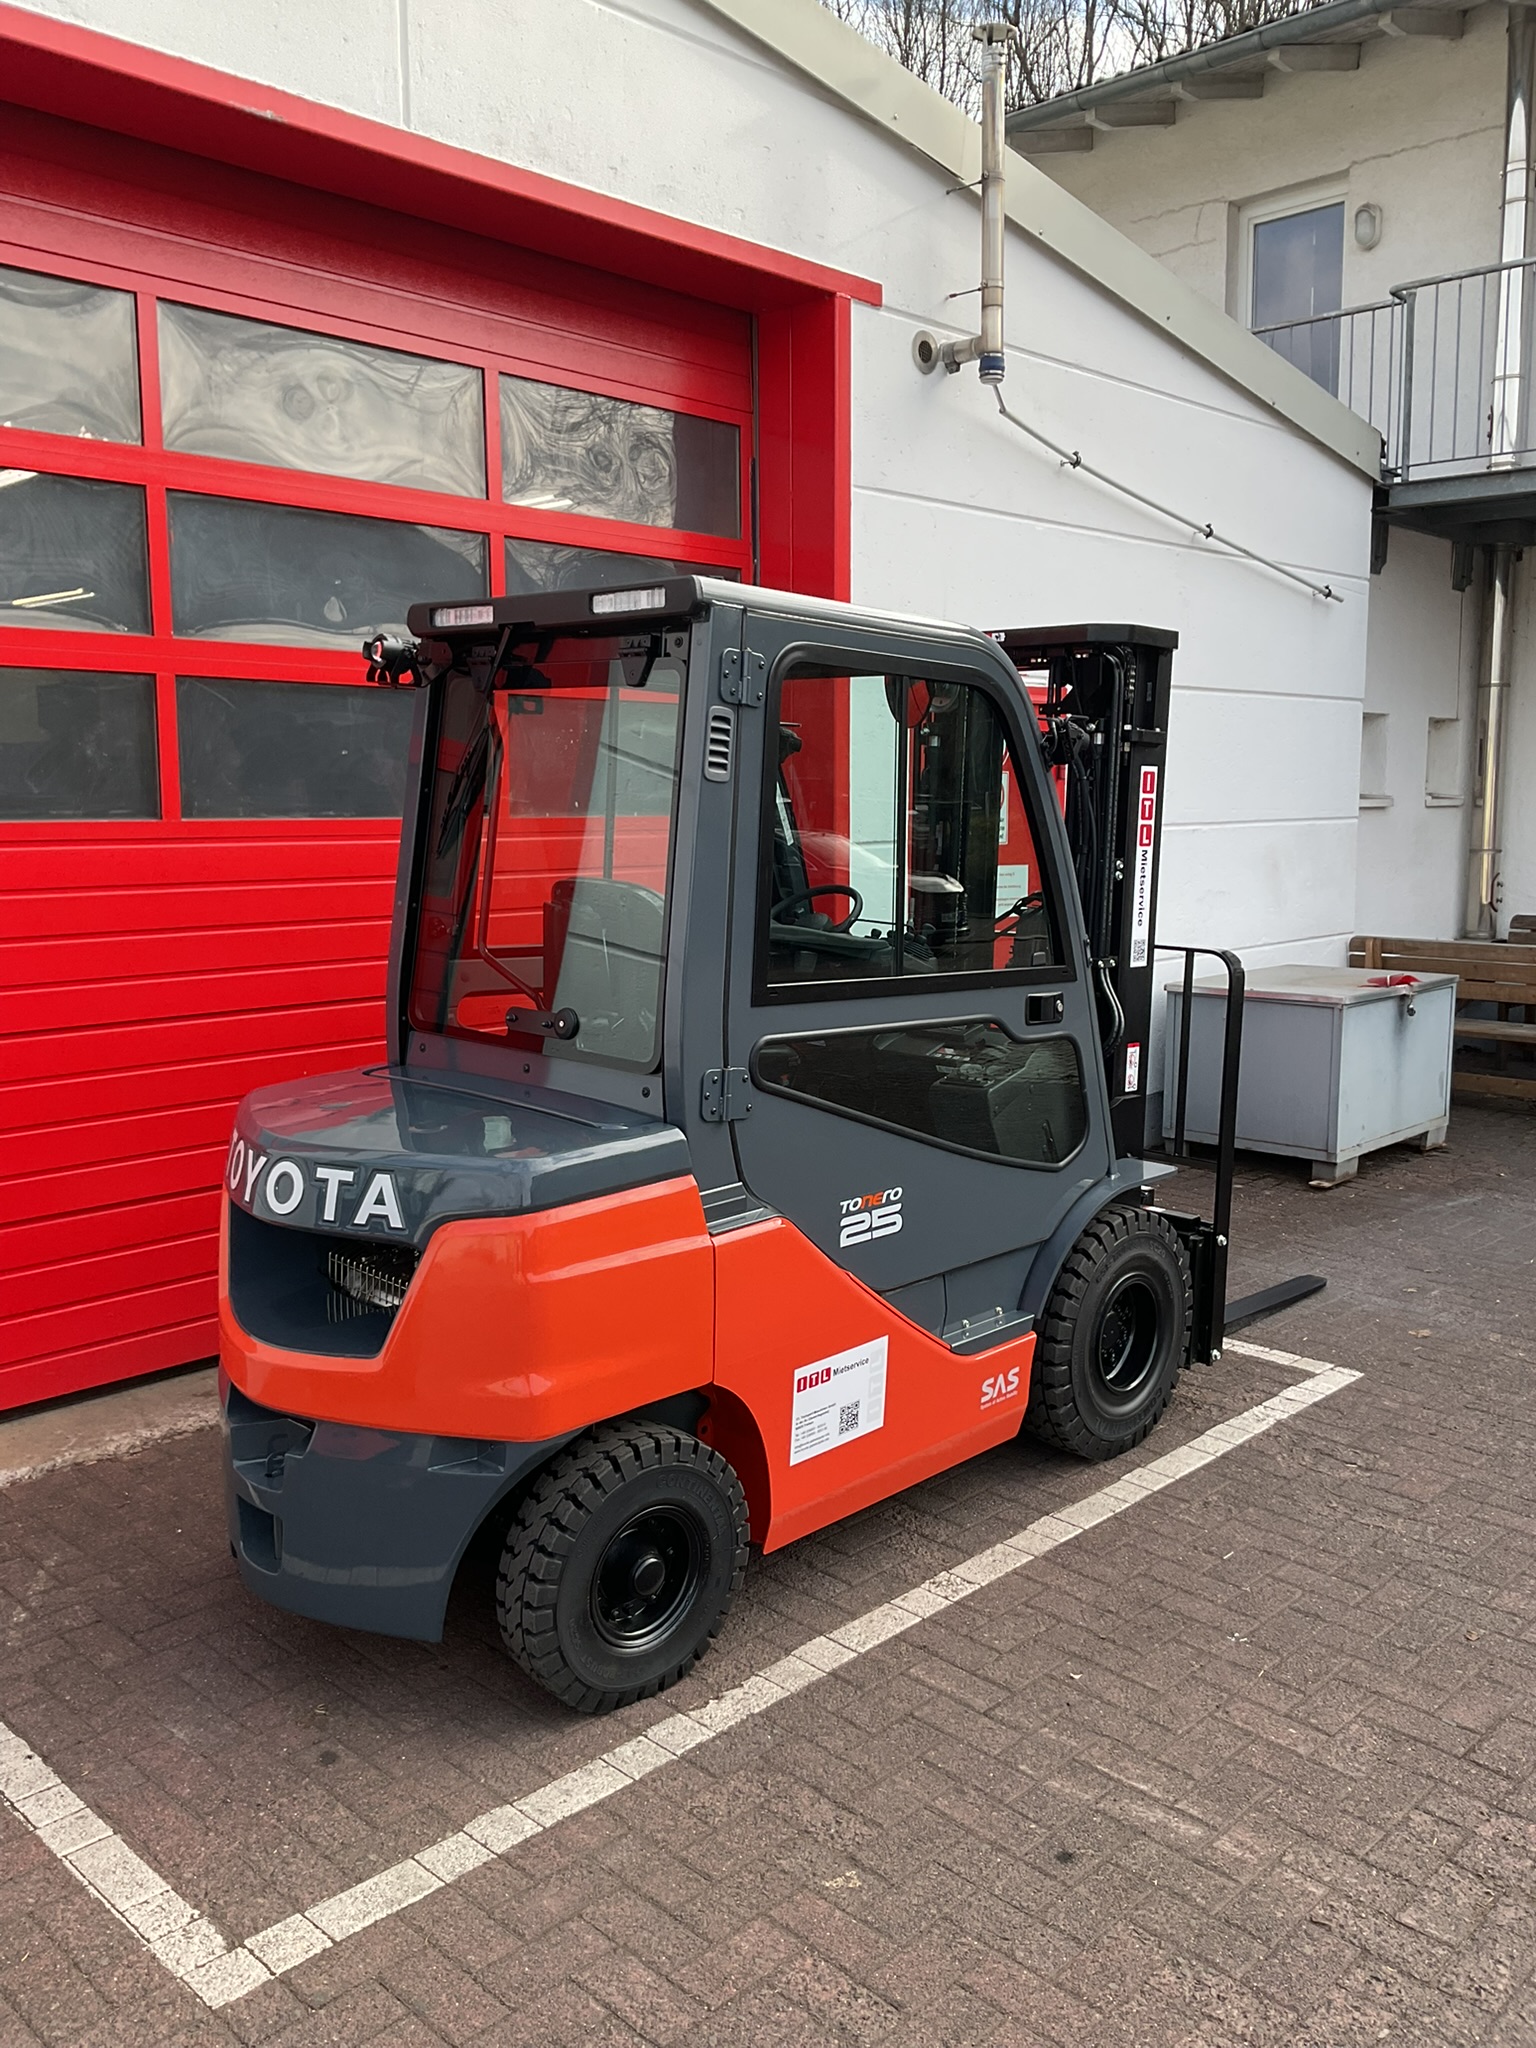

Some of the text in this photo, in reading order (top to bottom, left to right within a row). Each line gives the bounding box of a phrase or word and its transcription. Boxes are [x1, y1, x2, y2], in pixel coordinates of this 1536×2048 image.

[1137, 772, 1155, 926] ITL Mietservice
[226, 1130, 404, 1228] TOYOTA
[840, 1203, 903, 1248] 25
[797, 1358, 869, 1393] ITL Mietservice
[981, 1366, 1020, 1404] SAS
[656, 1473, 727, 1541] CONTINENTAL
